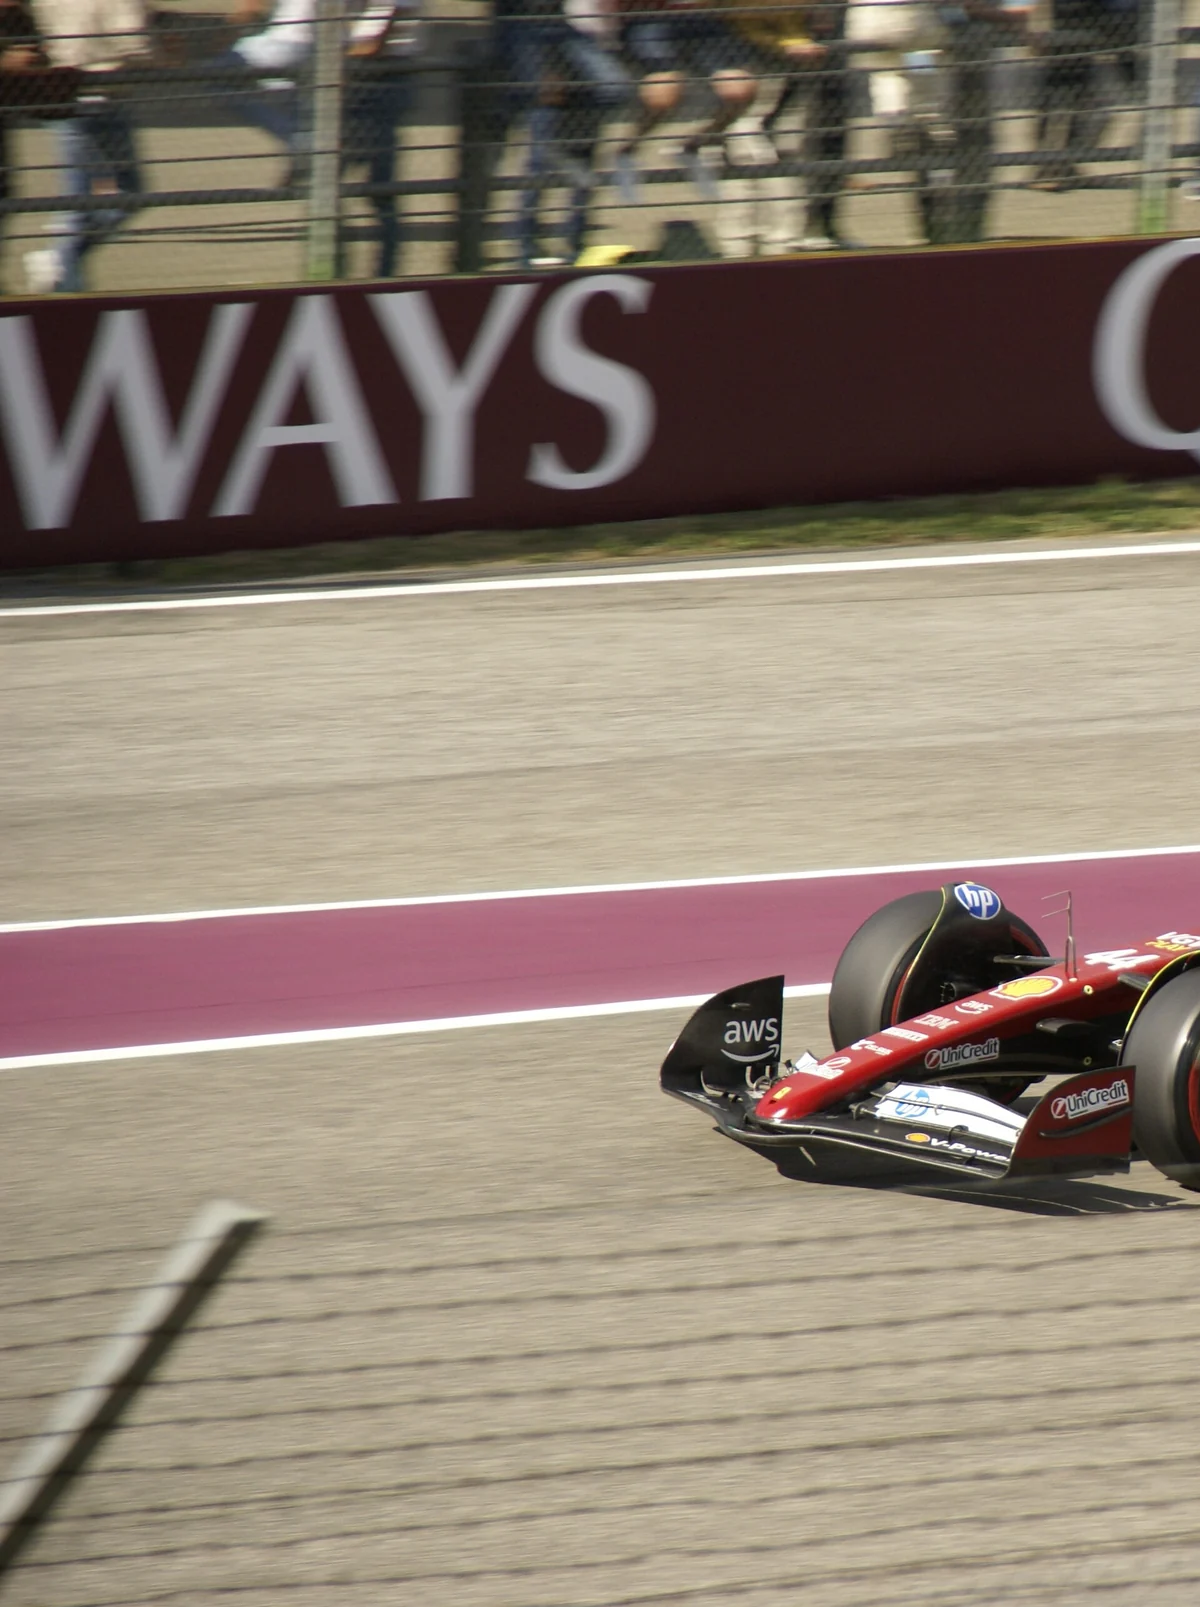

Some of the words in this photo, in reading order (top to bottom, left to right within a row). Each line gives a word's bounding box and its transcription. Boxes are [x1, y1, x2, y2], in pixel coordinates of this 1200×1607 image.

[0, 274, 657, 530] WAYS
[959, 884, 997, 919] hp
[724, 1018, 779, 1044] aws
[941, 1037, 999, 1066] UniCredit
[1067, 1080, 1129, 1114] UniCredit
